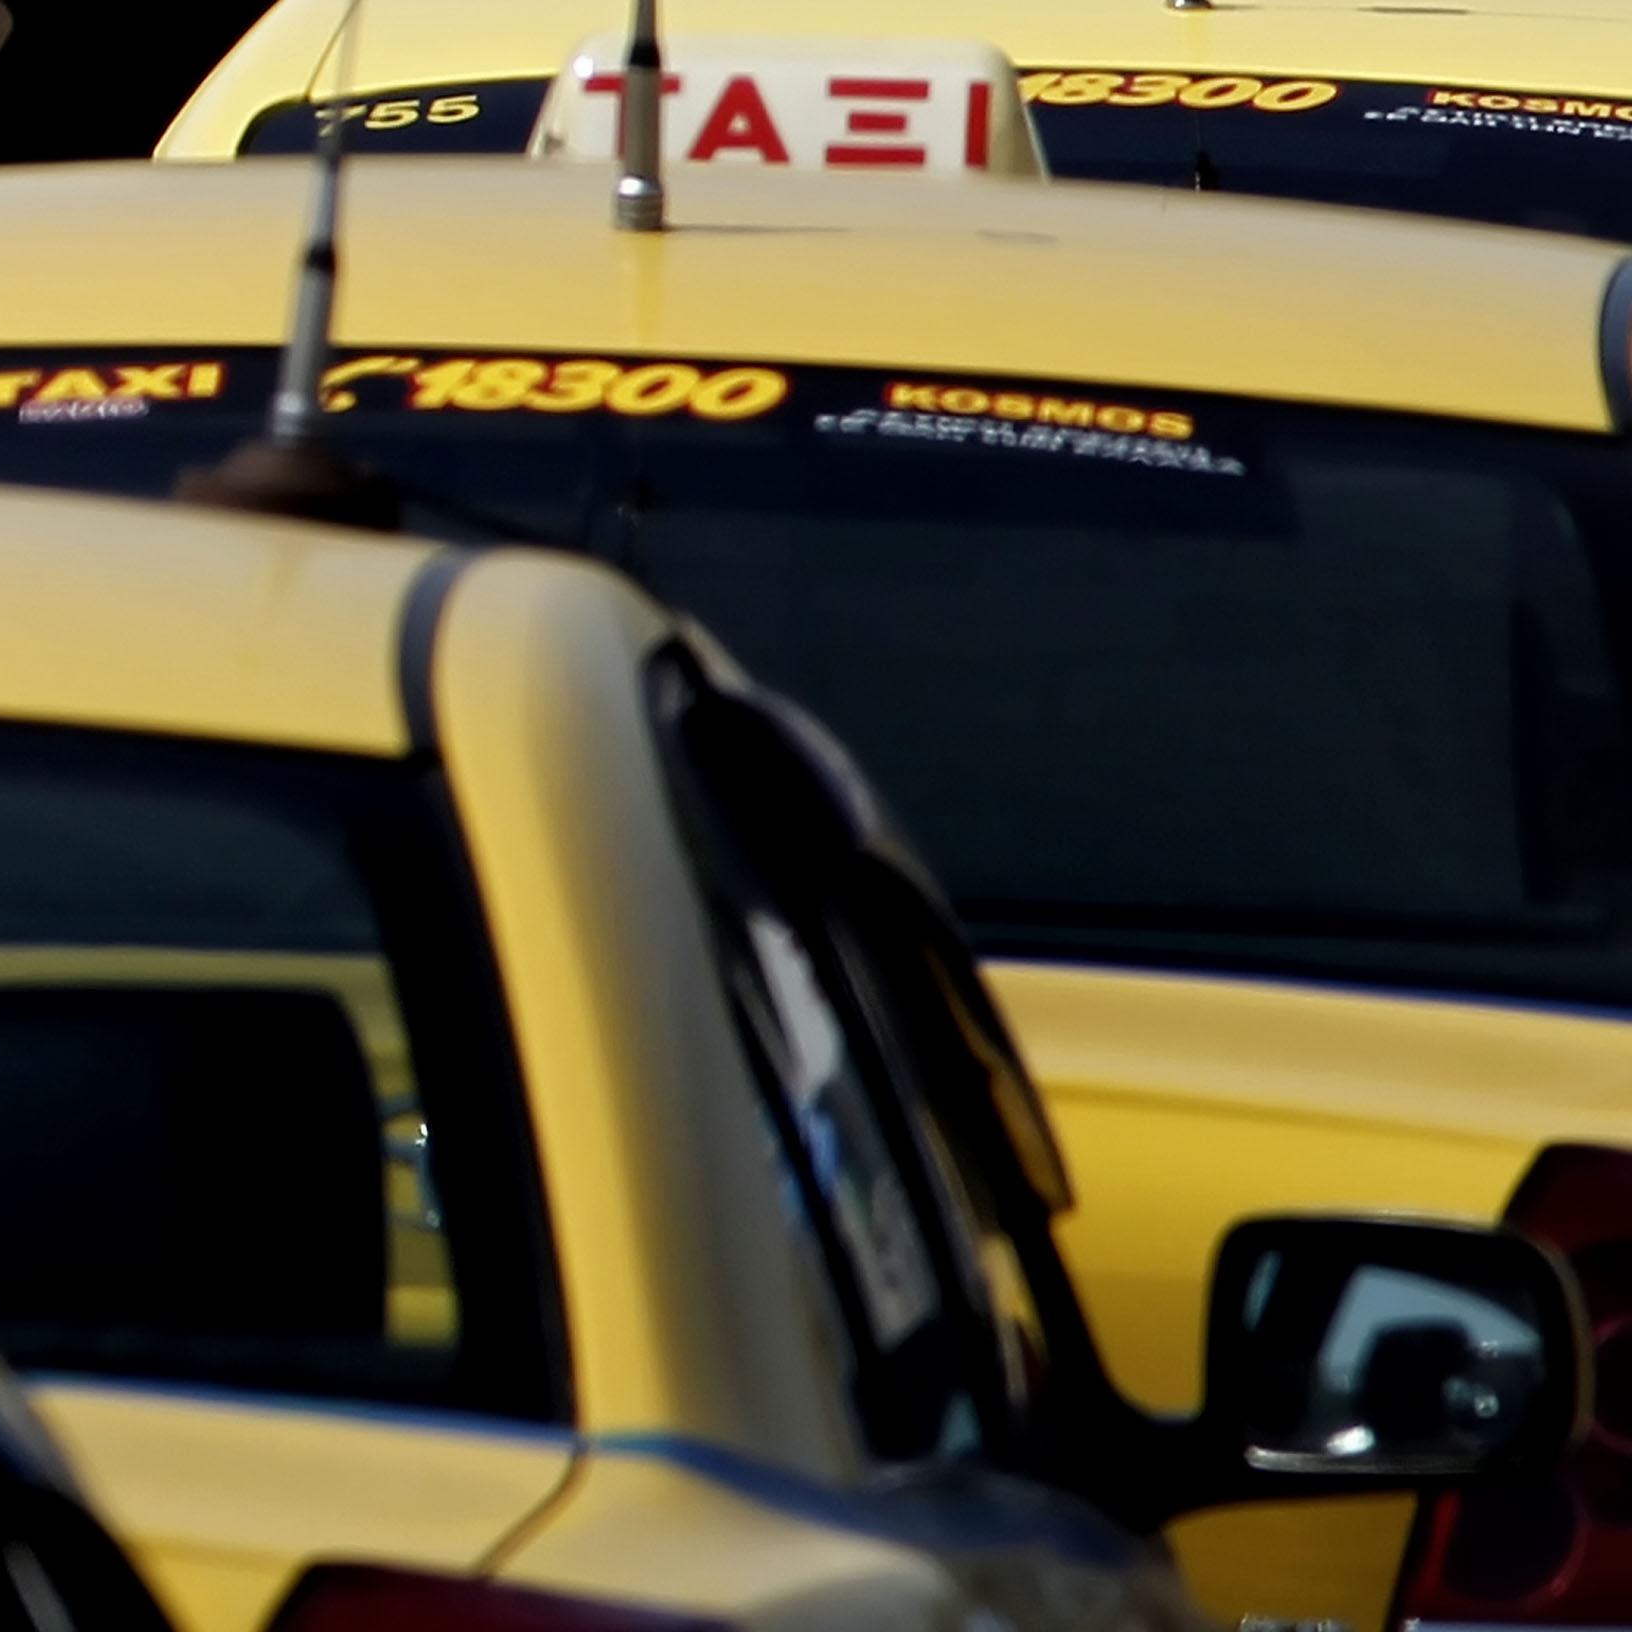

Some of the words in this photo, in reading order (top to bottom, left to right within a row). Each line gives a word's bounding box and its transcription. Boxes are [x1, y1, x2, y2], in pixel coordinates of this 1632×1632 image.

[584, 75, 991, 167] ΤΑΞΙ
[1017, 71, 1338, 112] 18300
[411, 358, 788, 421] 18300
[884, 382, 1194, 440] KOSMOS
